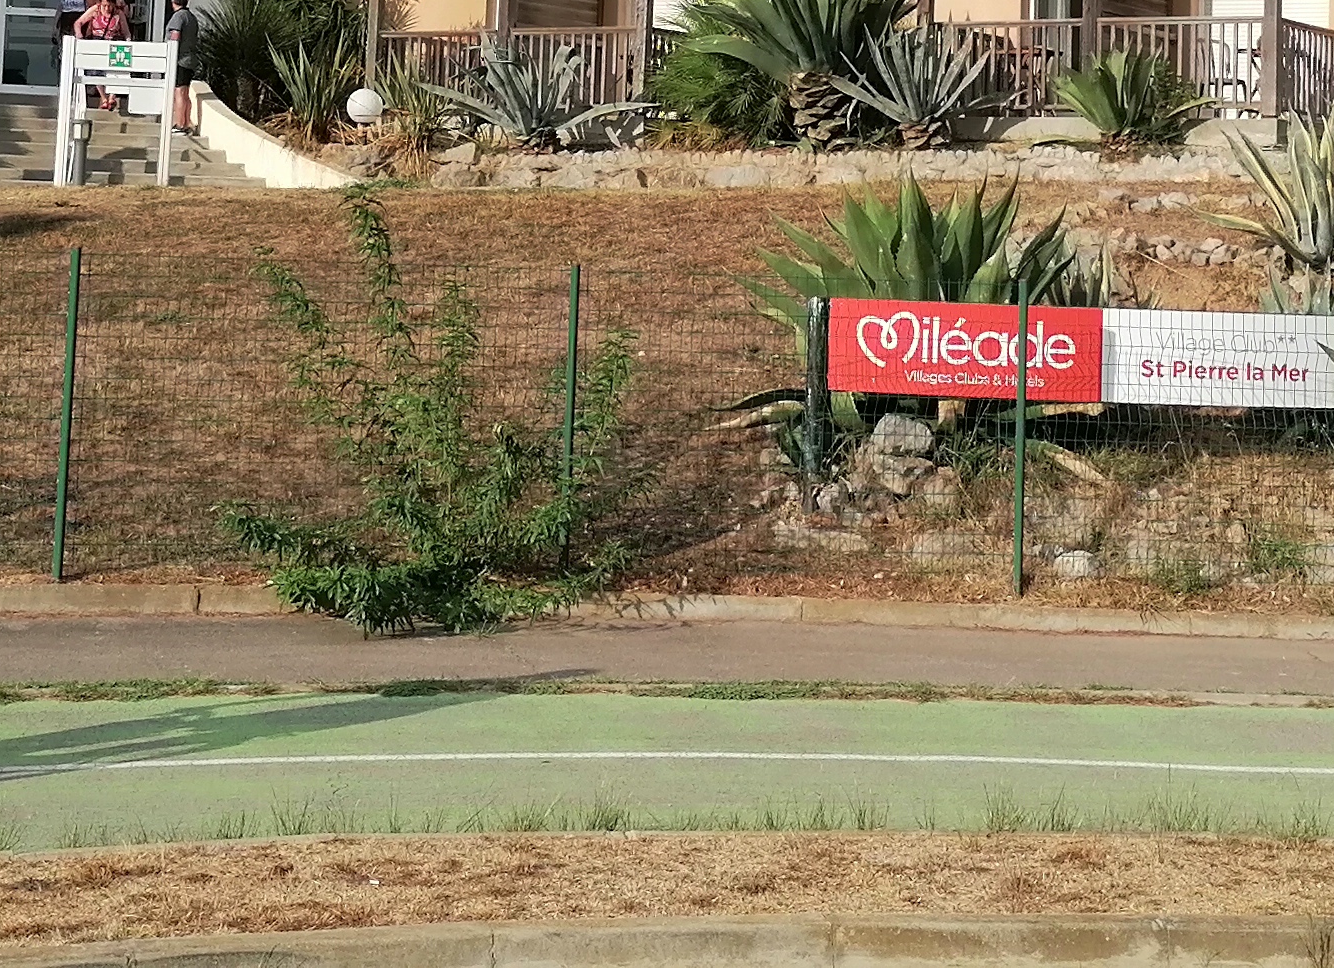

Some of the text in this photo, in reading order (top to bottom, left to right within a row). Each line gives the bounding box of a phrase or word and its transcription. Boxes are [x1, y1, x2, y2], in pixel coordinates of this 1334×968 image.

[856, 311, 1076, 370] Miléade
[1155, 331, 1225, 355] Village
[904, 370, 953, 385] Villages
[1005, 373, 1046, 388] Hels
[1141, 360, 1309, 383] St Pierre la Mer
